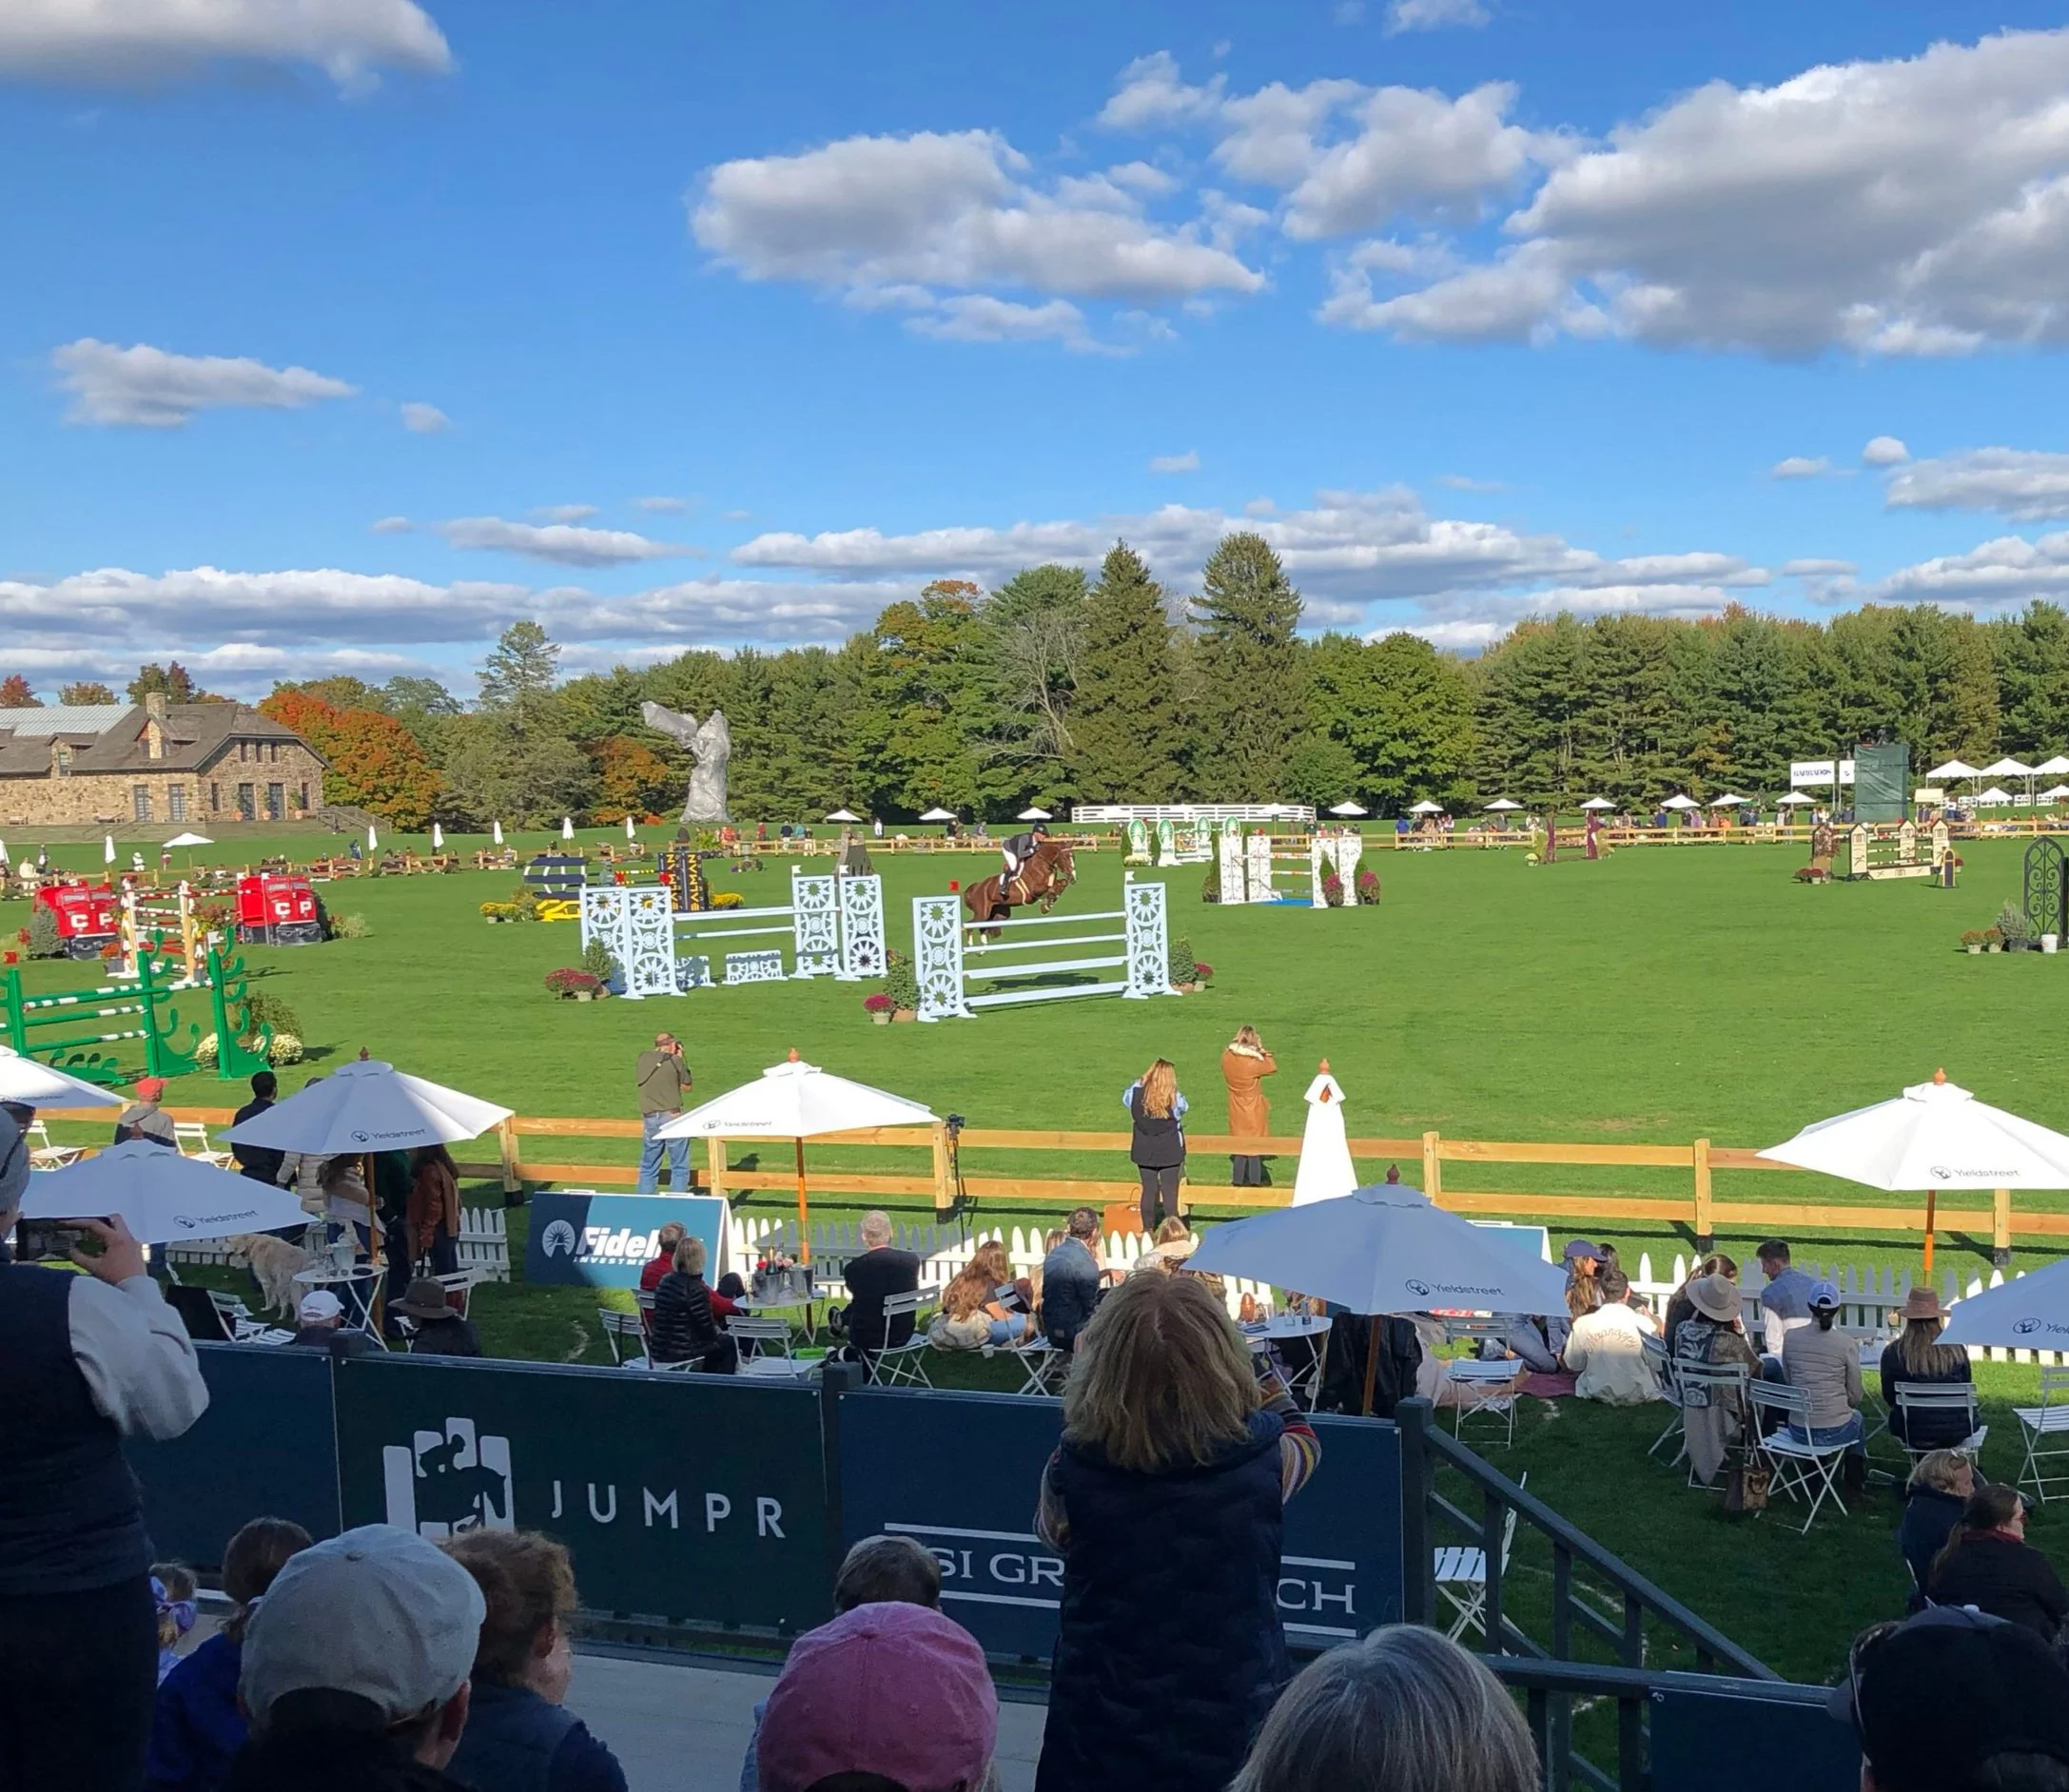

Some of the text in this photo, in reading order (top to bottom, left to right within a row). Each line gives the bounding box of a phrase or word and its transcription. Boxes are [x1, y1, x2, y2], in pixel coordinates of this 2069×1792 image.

[275, 901, 313, 915] CP
[573, 1256, 651, 1266] INVESTME
[1431, 1282, 1506, 1295] Yieldstreet
[551, 1480, 786, 1538] JUMPR
[927, 1547, 1357, 1614] SI GR CH
